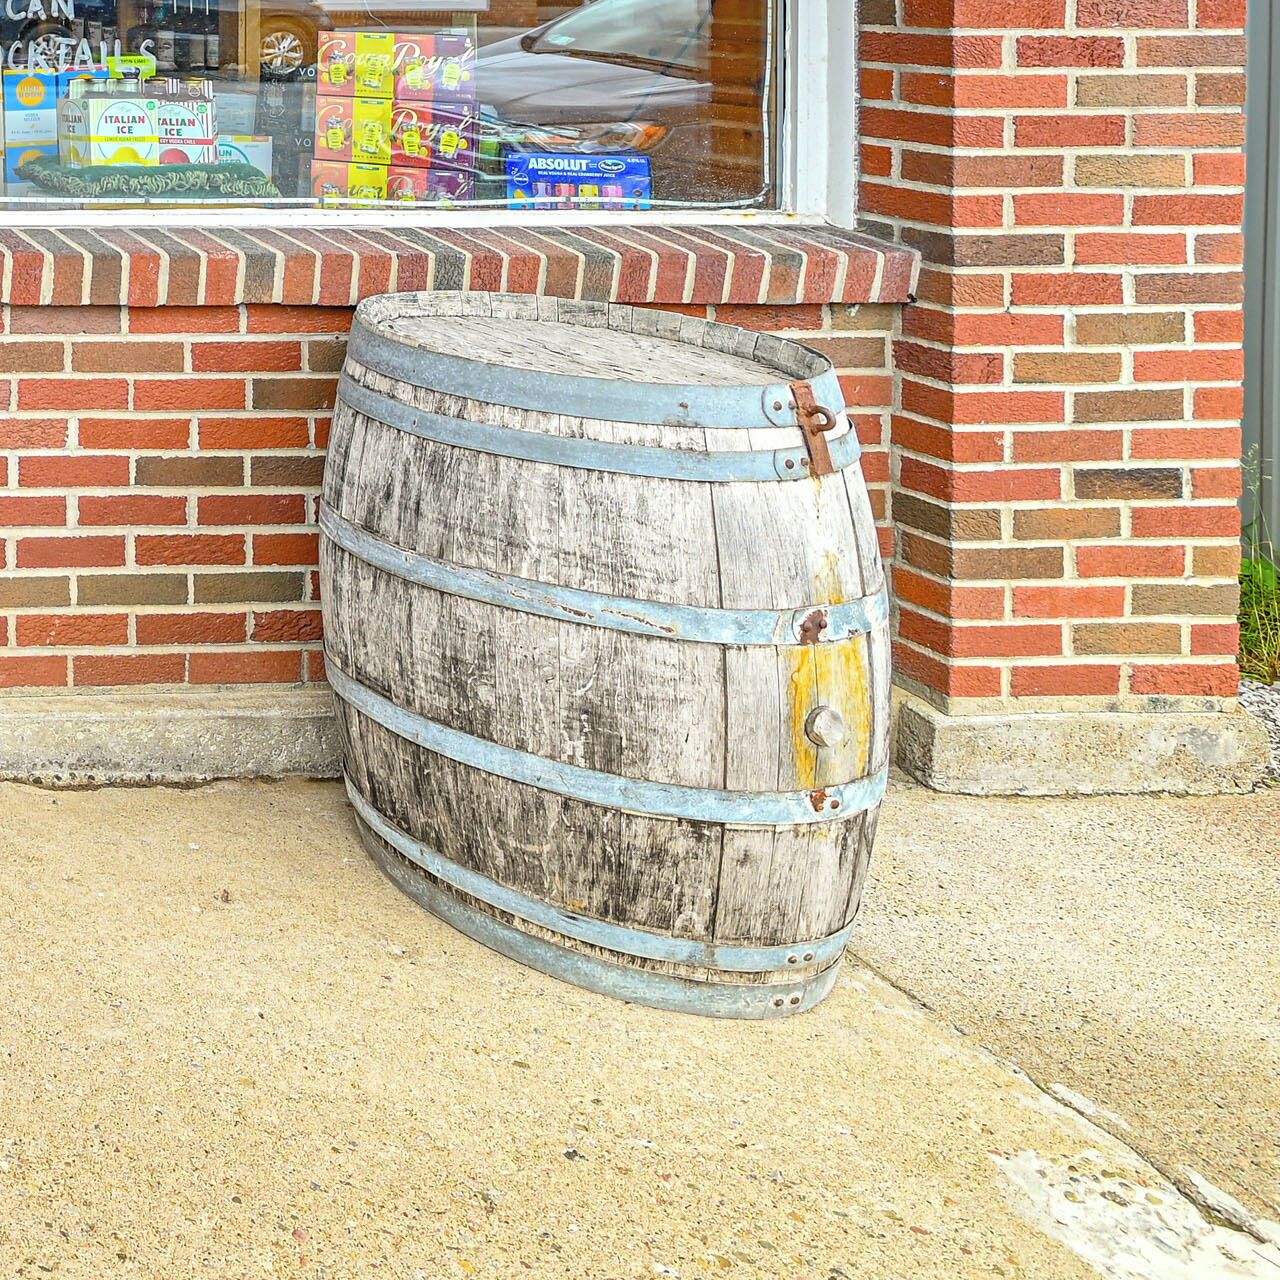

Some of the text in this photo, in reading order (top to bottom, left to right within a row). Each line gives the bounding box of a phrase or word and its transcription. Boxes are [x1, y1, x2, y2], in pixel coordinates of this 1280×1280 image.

[104, 115, 145, 123] ITALIAN
[158, 118, 196, 126] TALIAN
[117, 126, 133, 134] ICE
[165, 128, 182, 136] ICE
[528, 158, 588, 170] ABSOLUT
